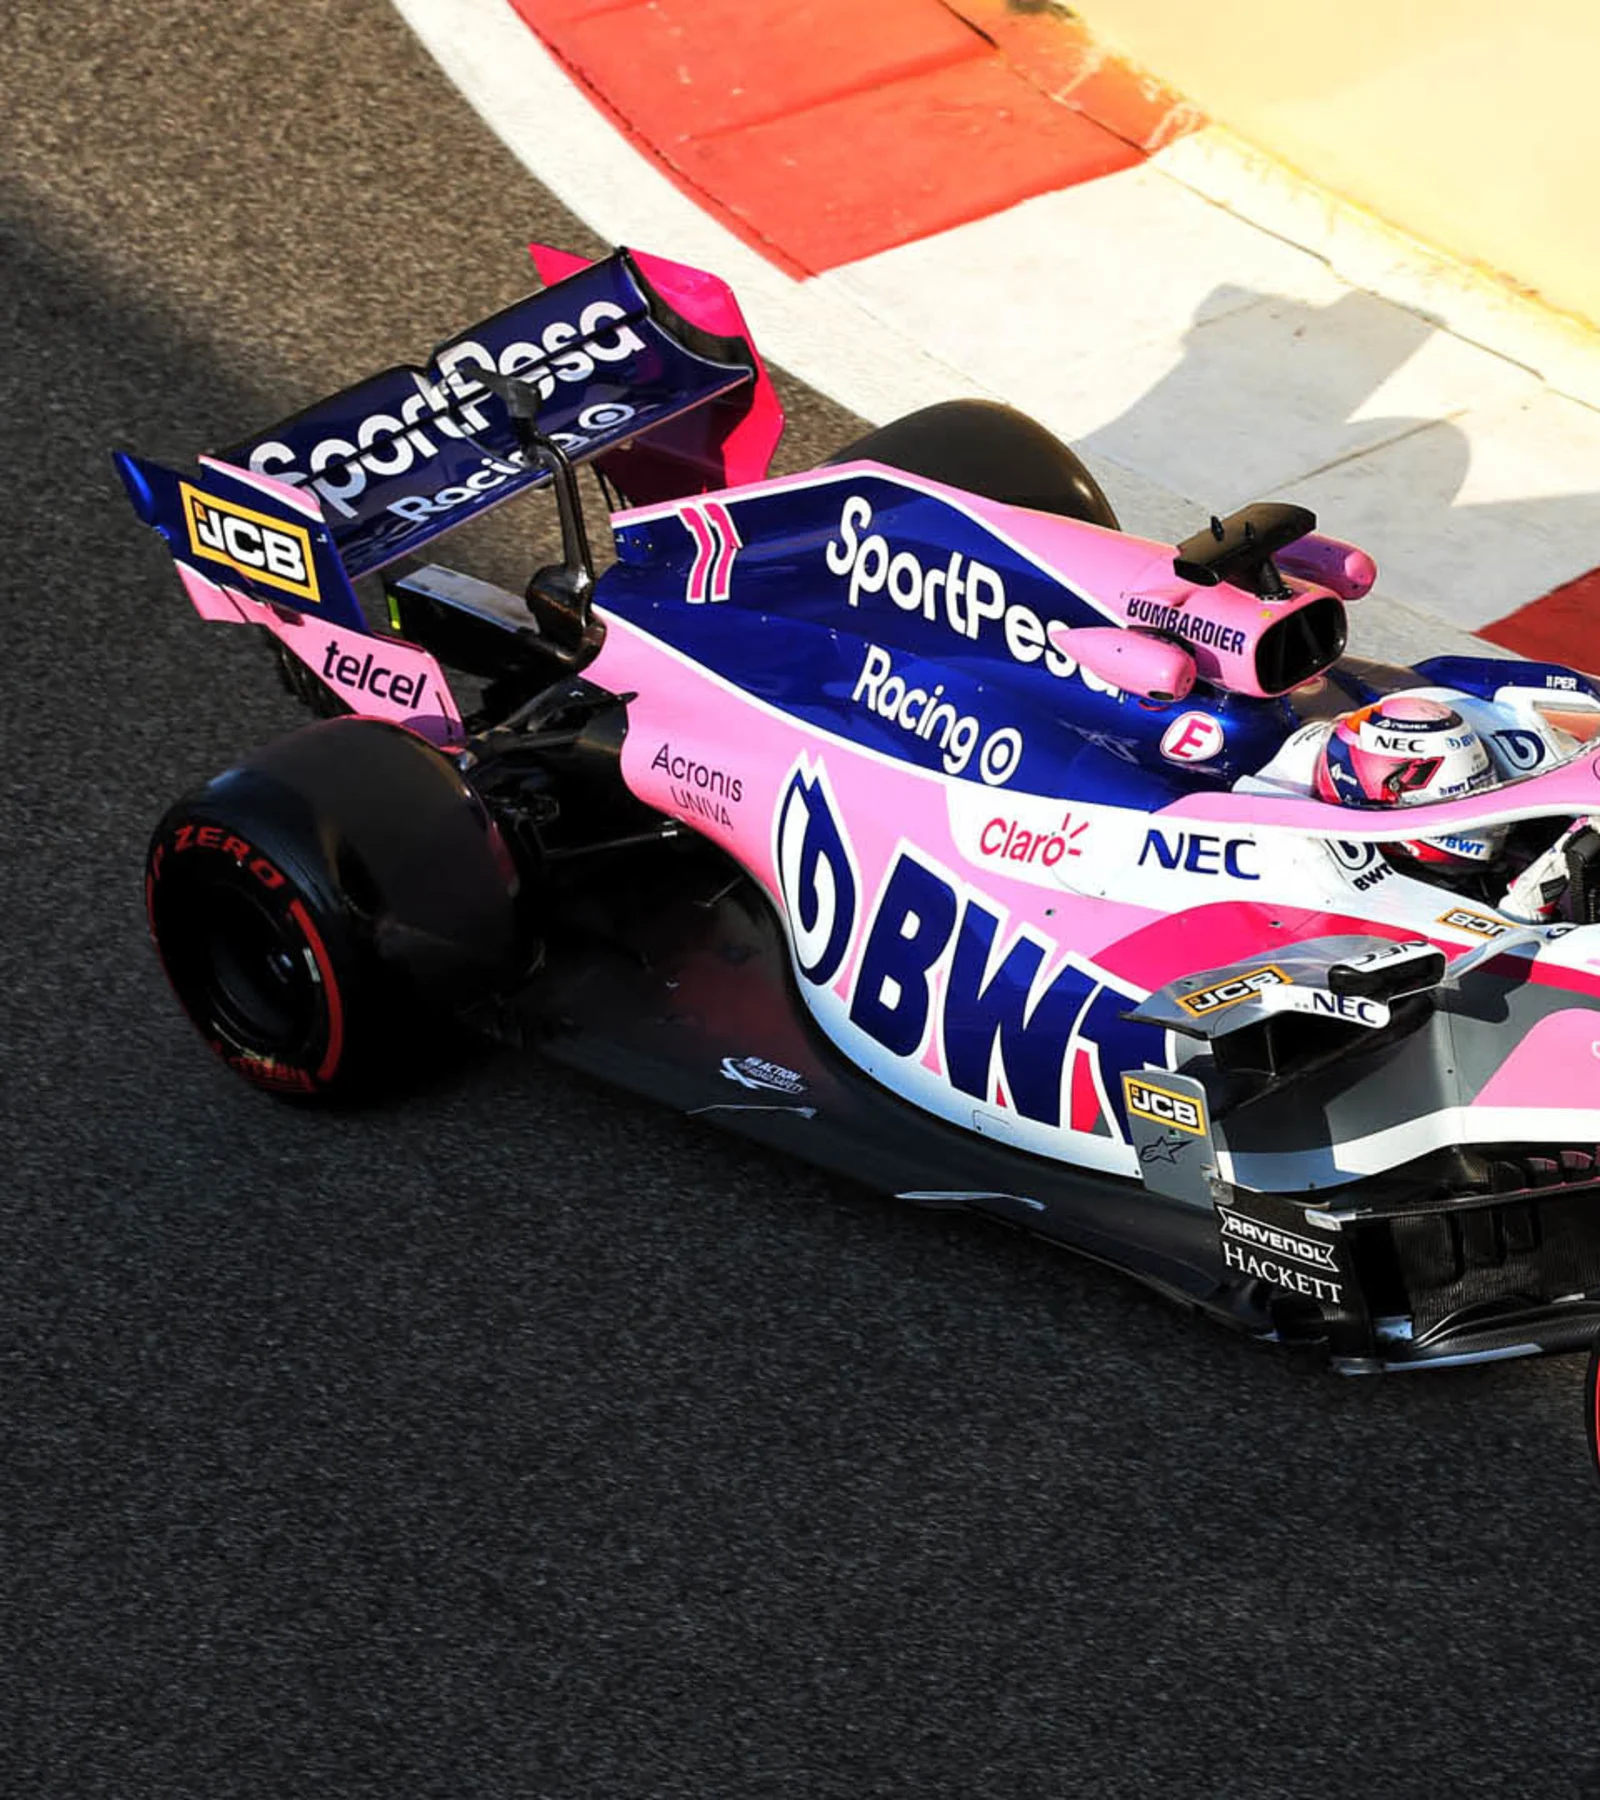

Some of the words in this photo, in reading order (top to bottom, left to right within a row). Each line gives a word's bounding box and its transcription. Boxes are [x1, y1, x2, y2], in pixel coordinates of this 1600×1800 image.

[249, 301, 647, 519] SportPesa
[387, 432, 590, 522] Raci
[198, 509, 306, 581] JCB
[1127, 598, 1246, 656] BOMBARDIER
[323, 640, 427, 709] telcel
[853, 644, 980, 775] Racing
[1169, 718, 1213, 758] E
[1375, 735, 1425, 753] NEC
[651, 743, 742, 803] Acronis
[670, 785, 734, 830] UNIVA
[175, 824, 286, 889] ZERO
[979, 817, 1065, 866] Claro
[1137, 829, 1261, 880] NEC
[1445, 836, 1485, 856] BWT
[1352, 862, 1394, 892] BWT
[849, 852, 1168, 1145] BWT
[1195, 971, 1281, 1010] JCB
[1313, 991, 1376, 1025] NEC
[1133, 1085, 1198, 1129] JCB
[1228, 1216, 1329, 1264] RAVENOL
[1222, 1241, 1343, 1305] HACKETT
